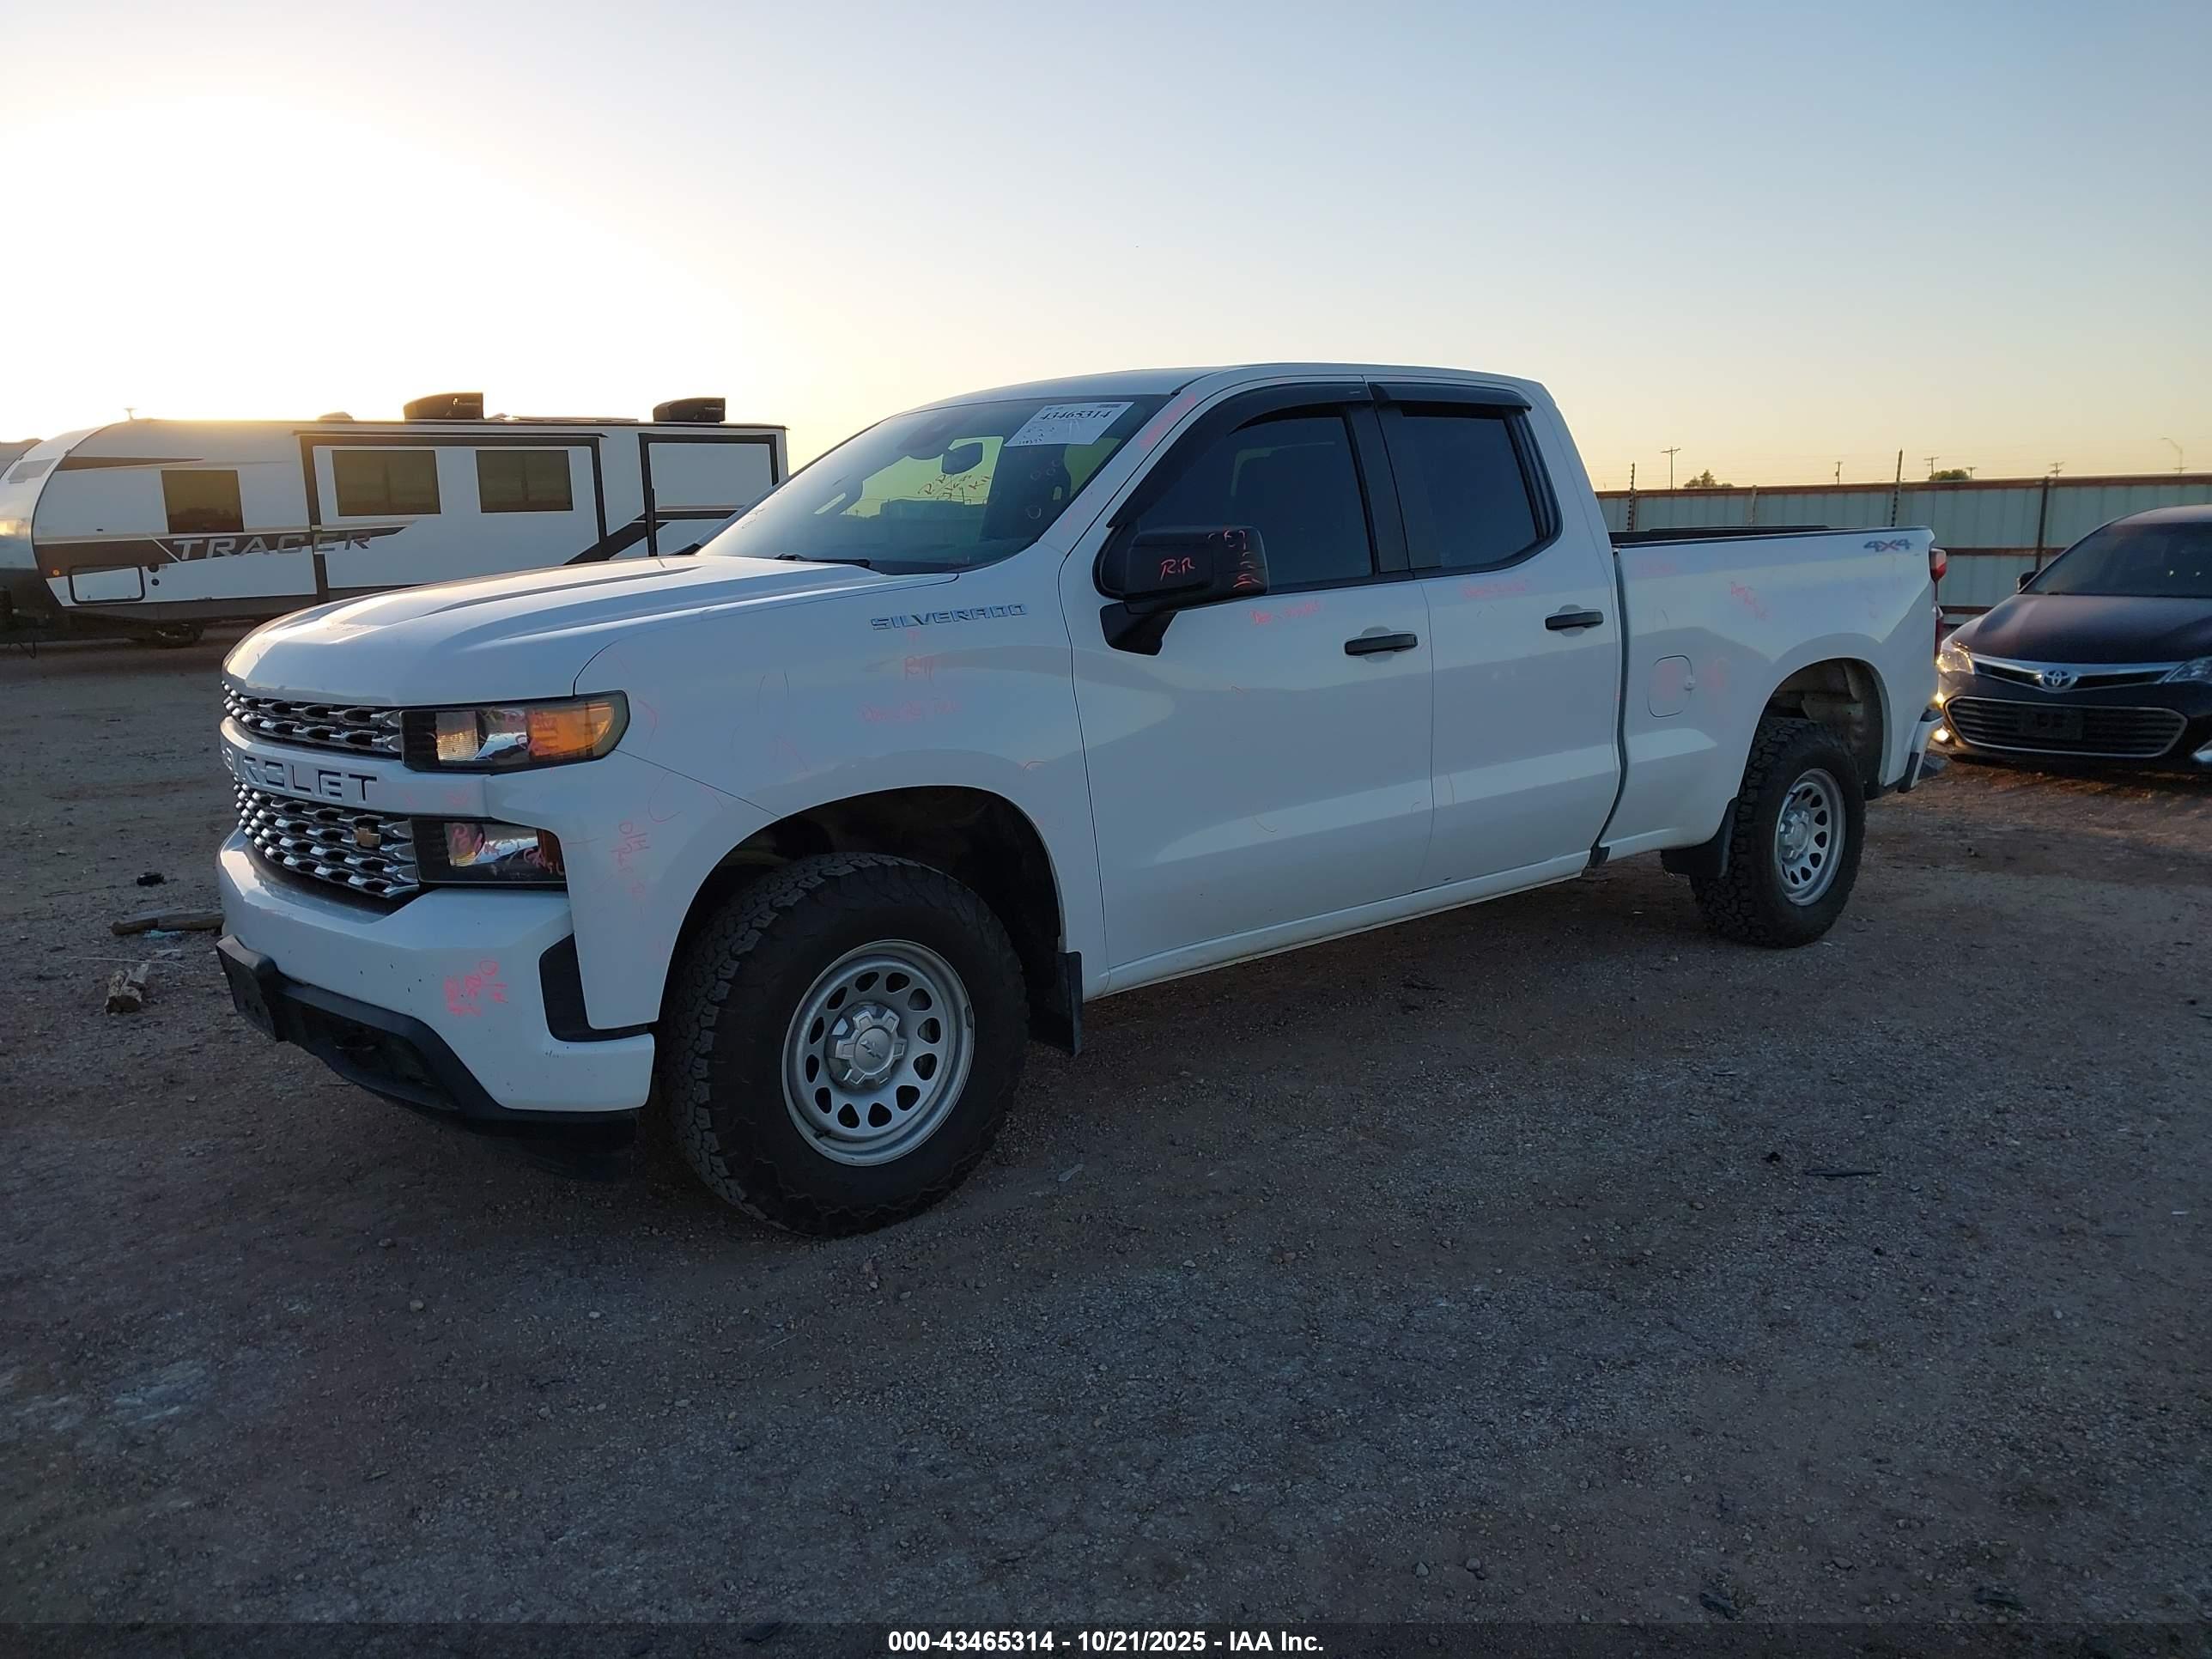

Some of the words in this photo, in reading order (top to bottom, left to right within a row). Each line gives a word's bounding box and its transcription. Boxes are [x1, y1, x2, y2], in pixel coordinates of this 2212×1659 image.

[1039, 410, 1114, 421] 43465314
[172, 531, 372, 561] TRACER
[871, 603, 1028, 631] SILVERADO
[222, 747, 378, 804] ROLET
